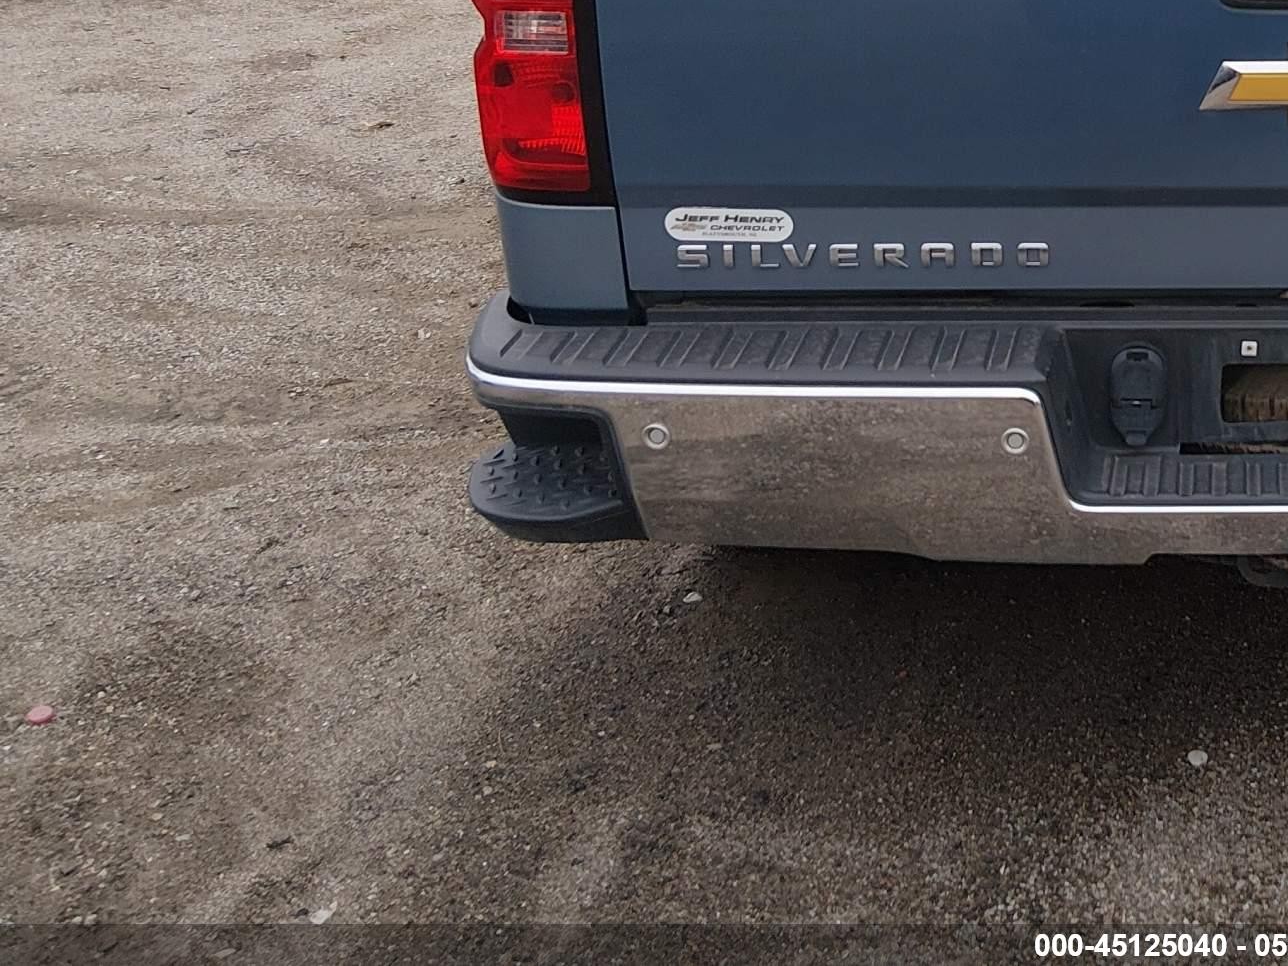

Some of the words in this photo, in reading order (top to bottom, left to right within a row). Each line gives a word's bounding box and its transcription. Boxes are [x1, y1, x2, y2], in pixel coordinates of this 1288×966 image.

[675, 213, 720, 222] JEFF
[724, 214, 785, 223] HENRY
[710, 224, 785, 232] CHEVROLET
[676, 242, 1050, 268] SILVERADO
